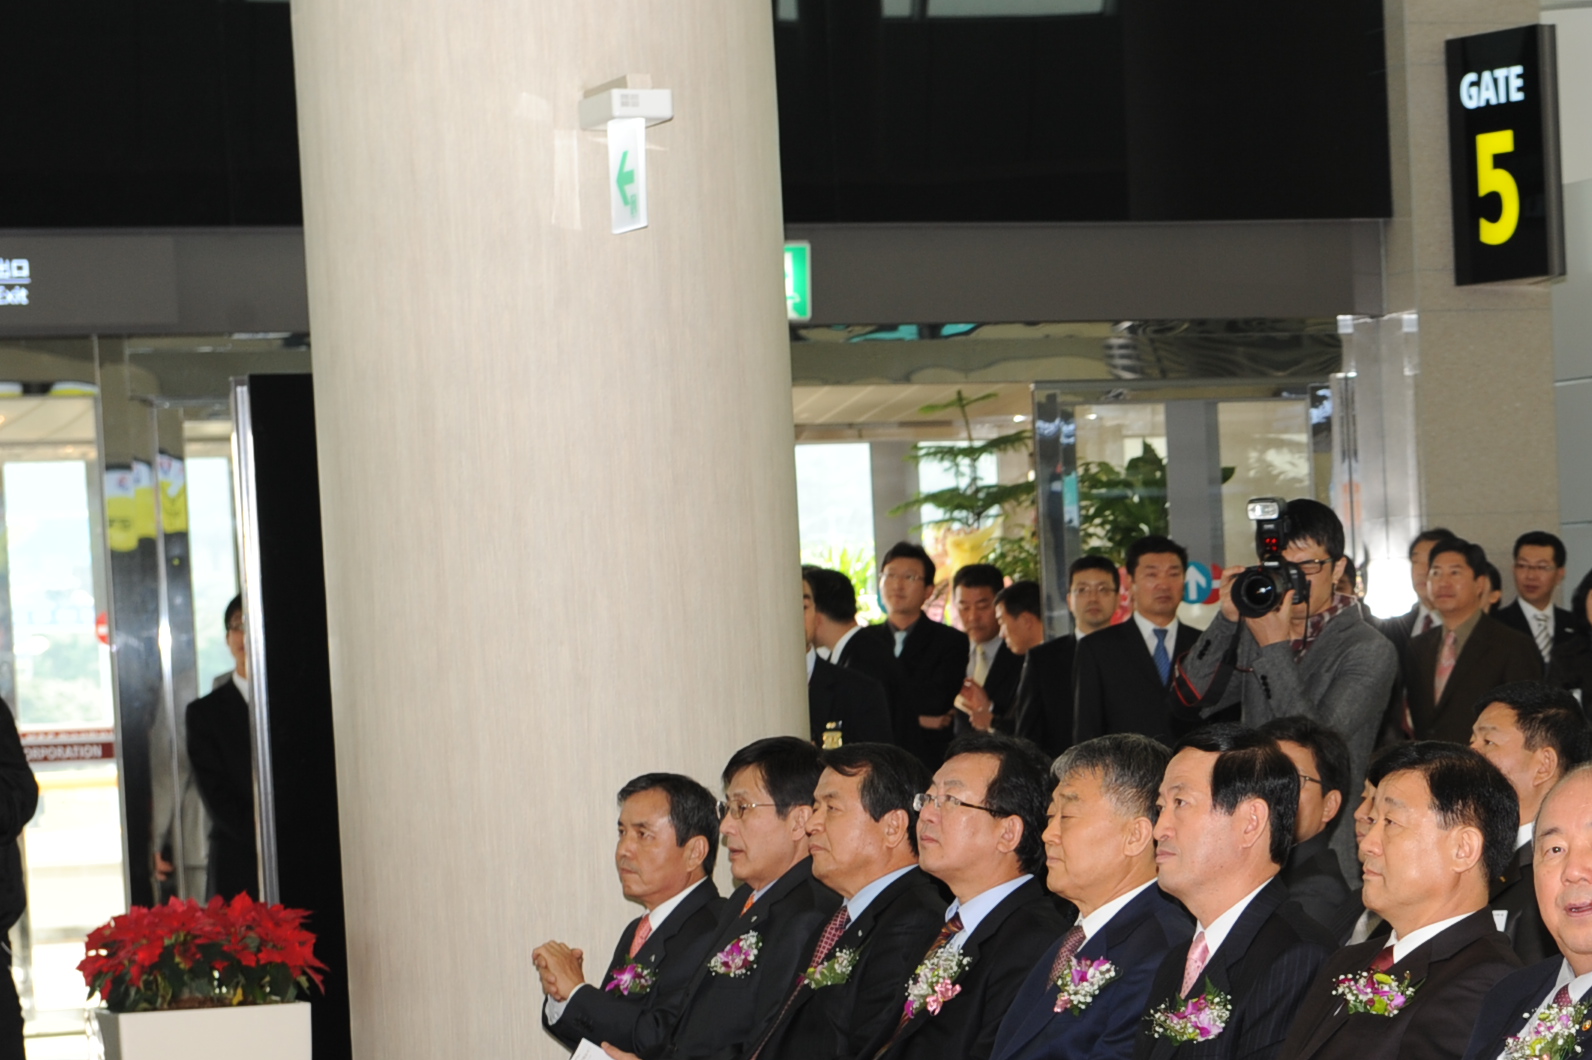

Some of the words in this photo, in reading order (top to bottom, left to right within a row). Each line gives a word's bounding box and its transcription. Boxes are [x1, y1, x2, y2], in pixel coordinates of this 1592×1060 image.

[1460, 65, 1525, 110] GATE
[1475, 129, 1520, 246] 5
[24, 744, 103, 761] ORPORATION
